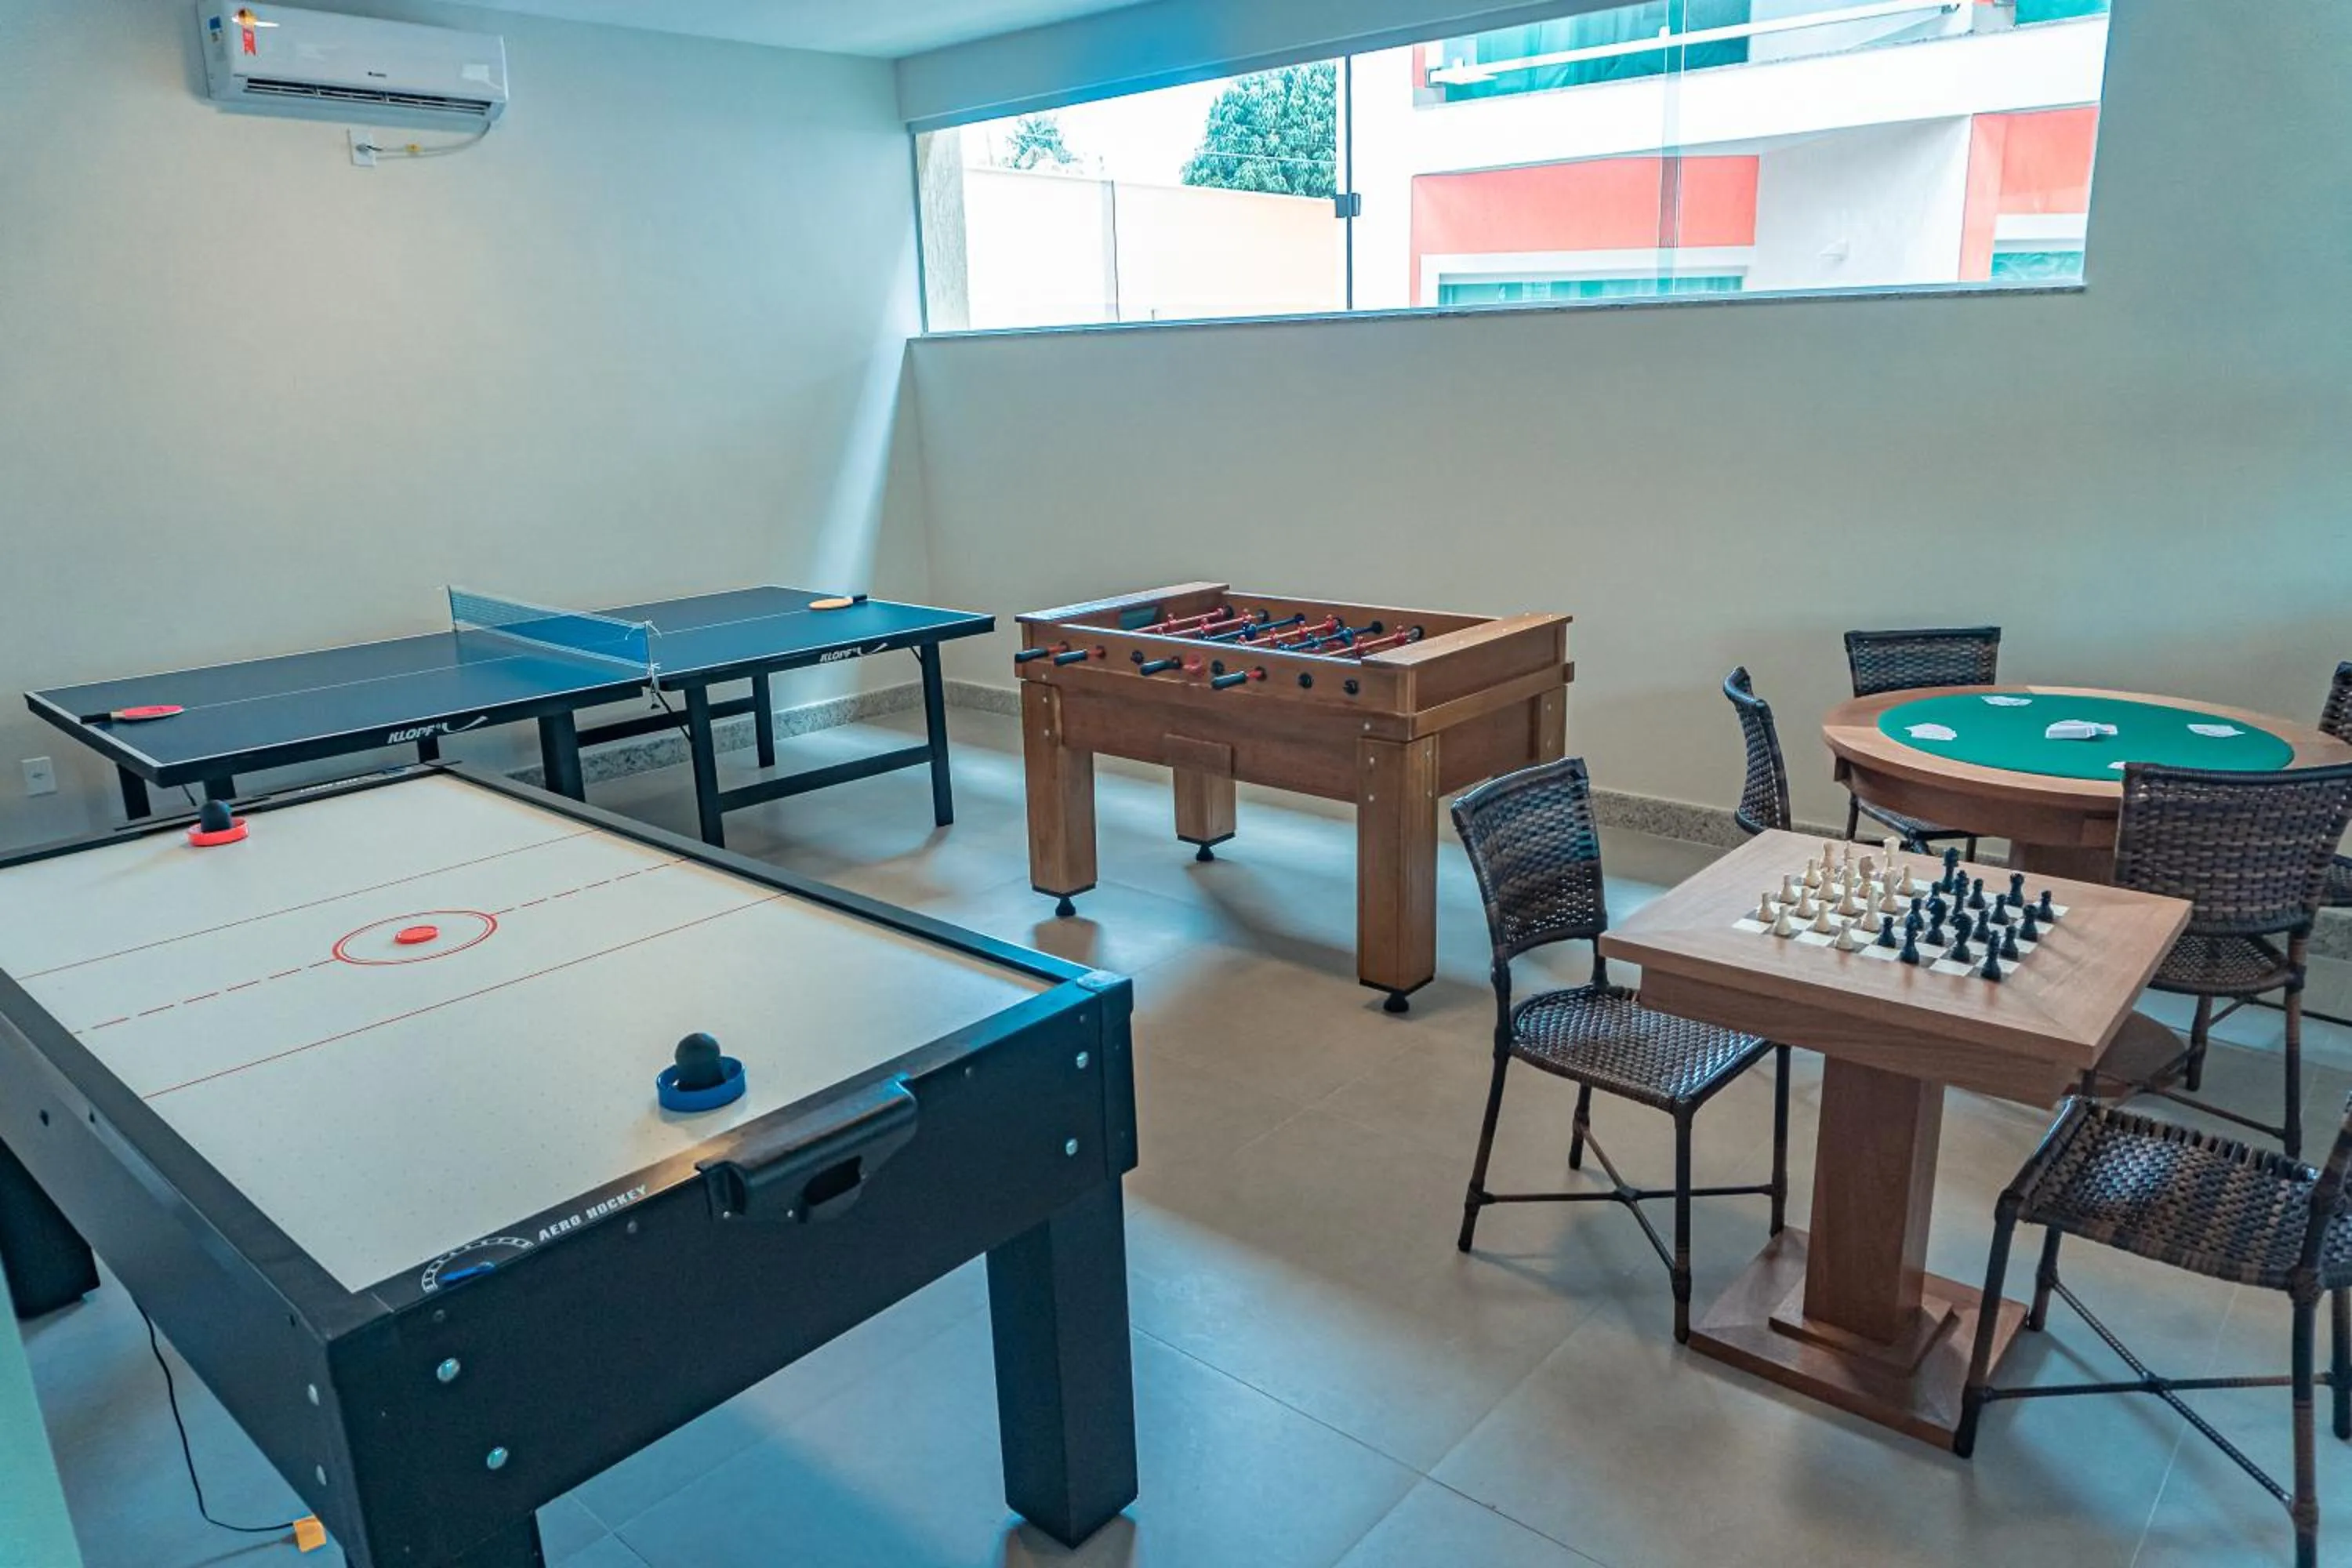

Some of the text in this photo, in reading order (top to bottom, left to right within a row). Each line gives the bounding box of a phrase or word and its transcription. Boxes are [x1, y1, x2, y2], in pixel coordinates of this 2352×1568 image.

[387, 724, 436, 744] KLOPF
[538, 1185, 647, 1241] AERO HOCKEY
